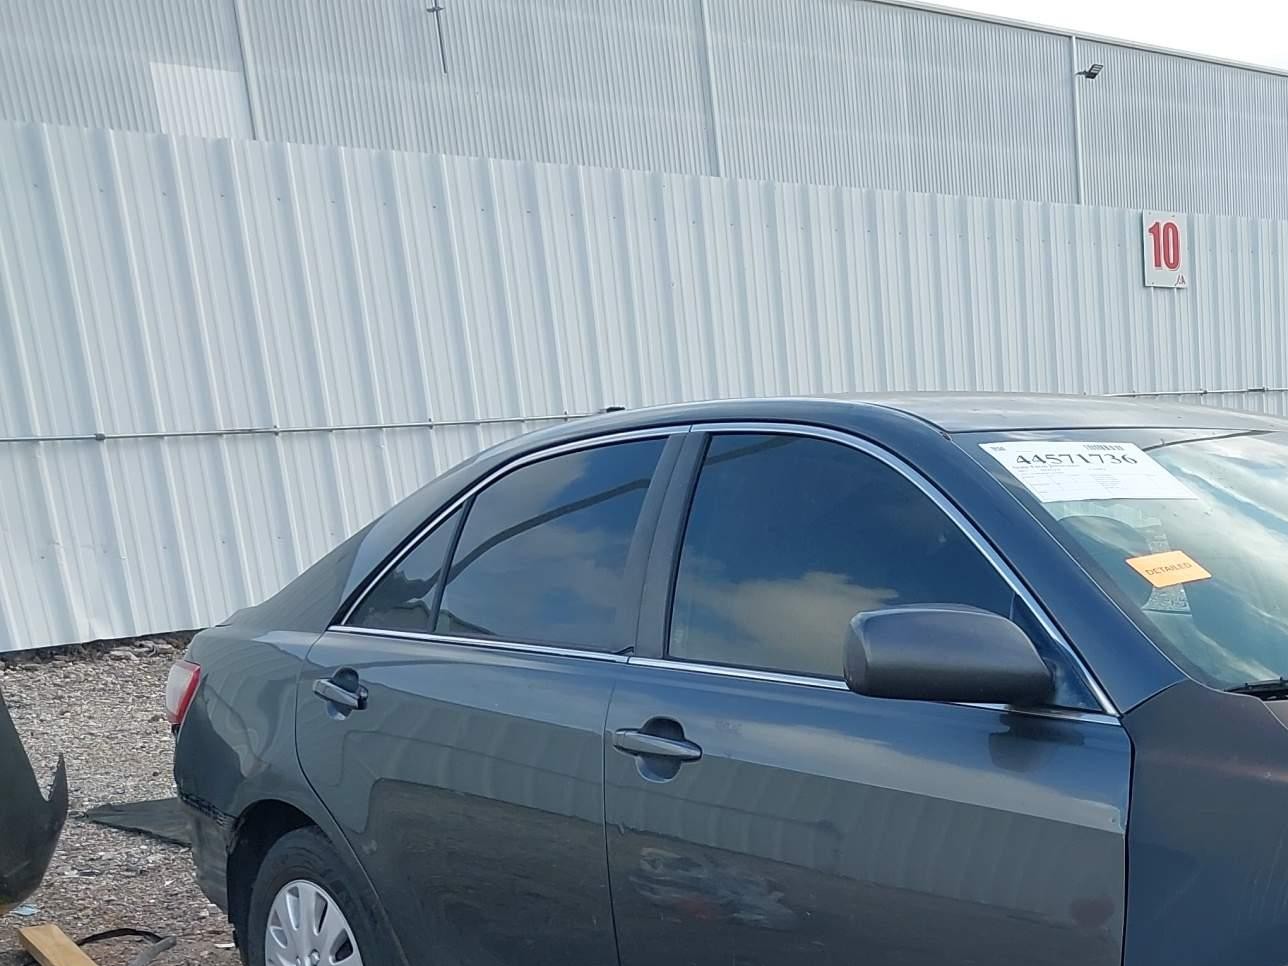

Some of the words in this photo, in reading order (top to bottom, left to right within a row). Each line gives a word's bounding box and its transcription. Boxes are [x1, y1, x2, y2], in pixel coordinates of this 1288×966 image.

[1148, 221, 1180, 270] 10
[1016, 453, 1138, 465] 44571736
[1145, 562, 1192, 576] DETAILED
